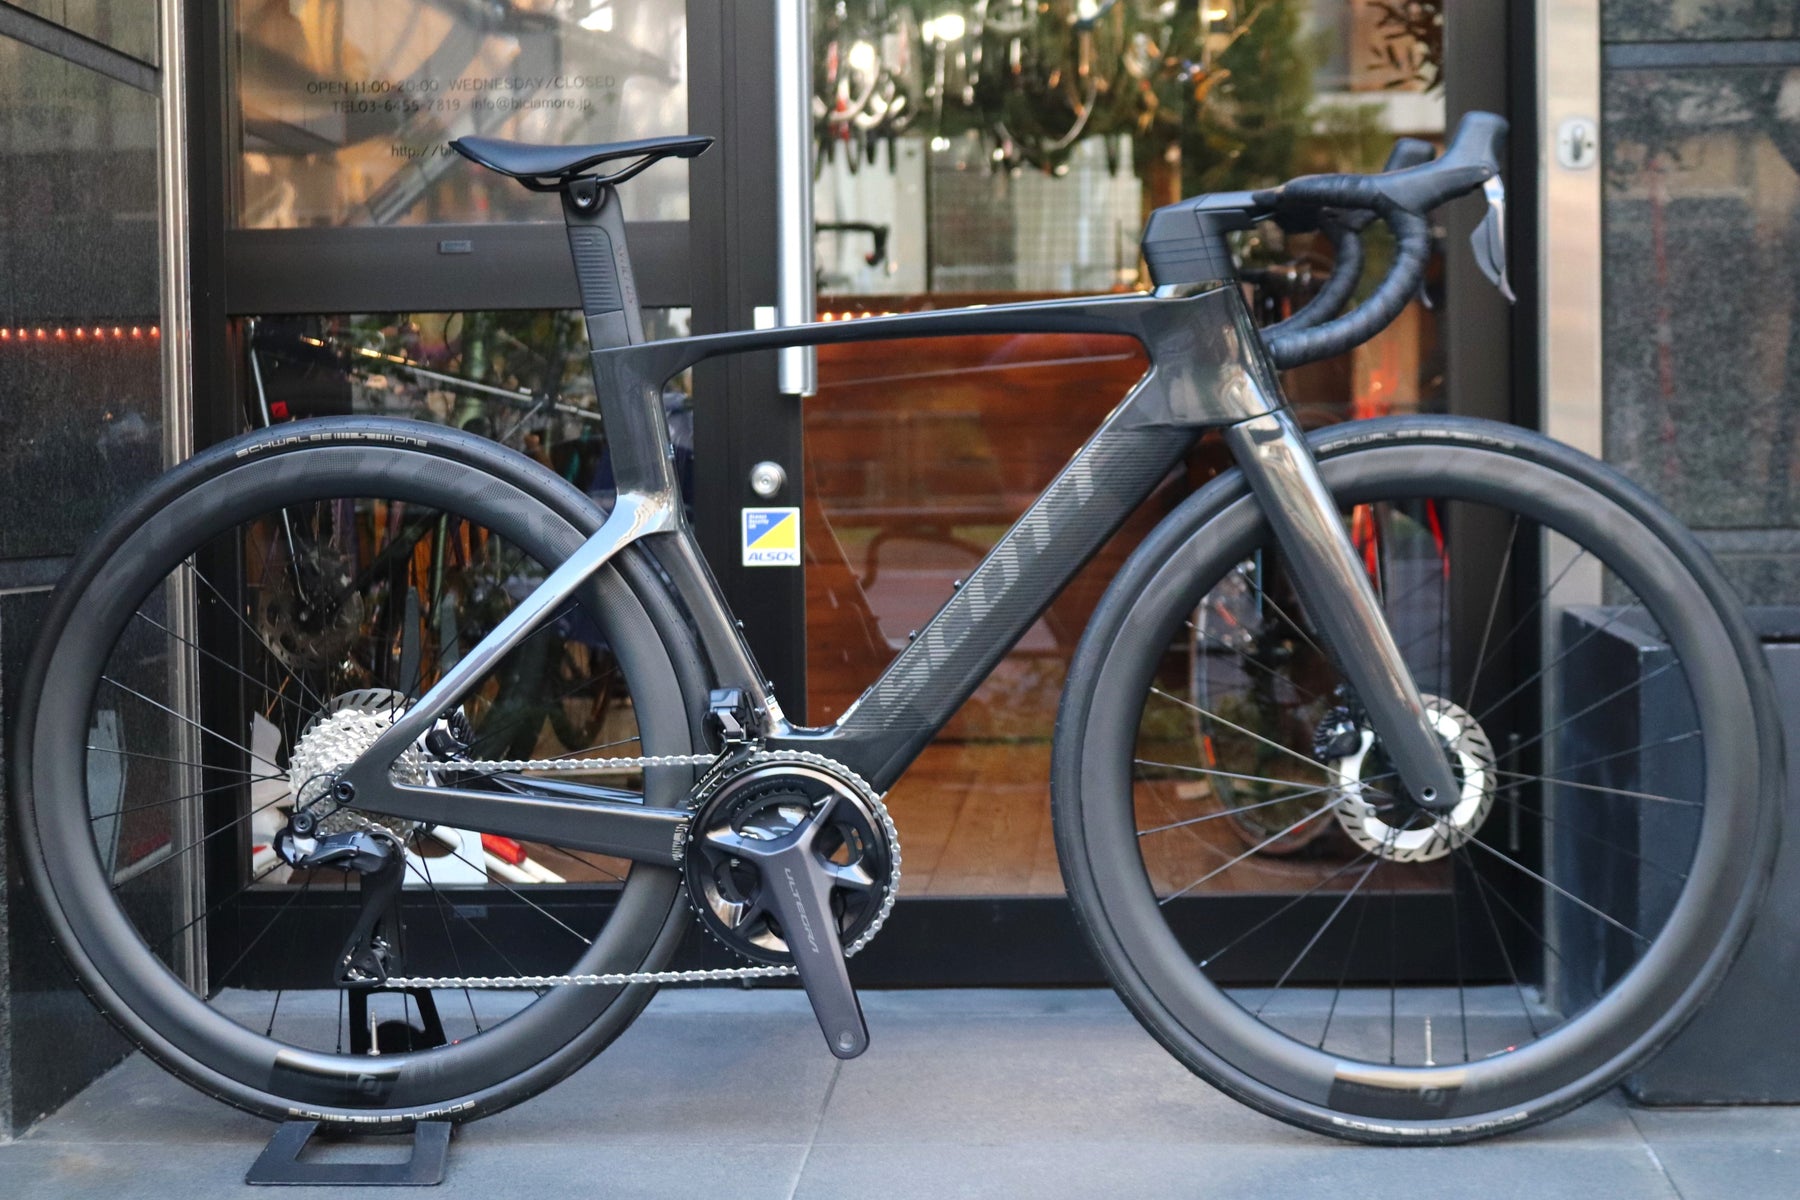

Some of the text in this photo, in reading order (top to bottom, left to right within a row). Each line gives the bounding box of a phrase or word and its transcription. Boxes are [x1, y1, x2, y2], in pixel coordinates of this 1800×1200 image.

[307, 81, 348, 94] OPEN
[236, 432, 428, 458] SCHWALBE ONE
[748, 551, 795, 561] ALSOK
[700, 751, 734, 784] ULTEGRA
[784, 867, 819, 954] ULTEGRA
